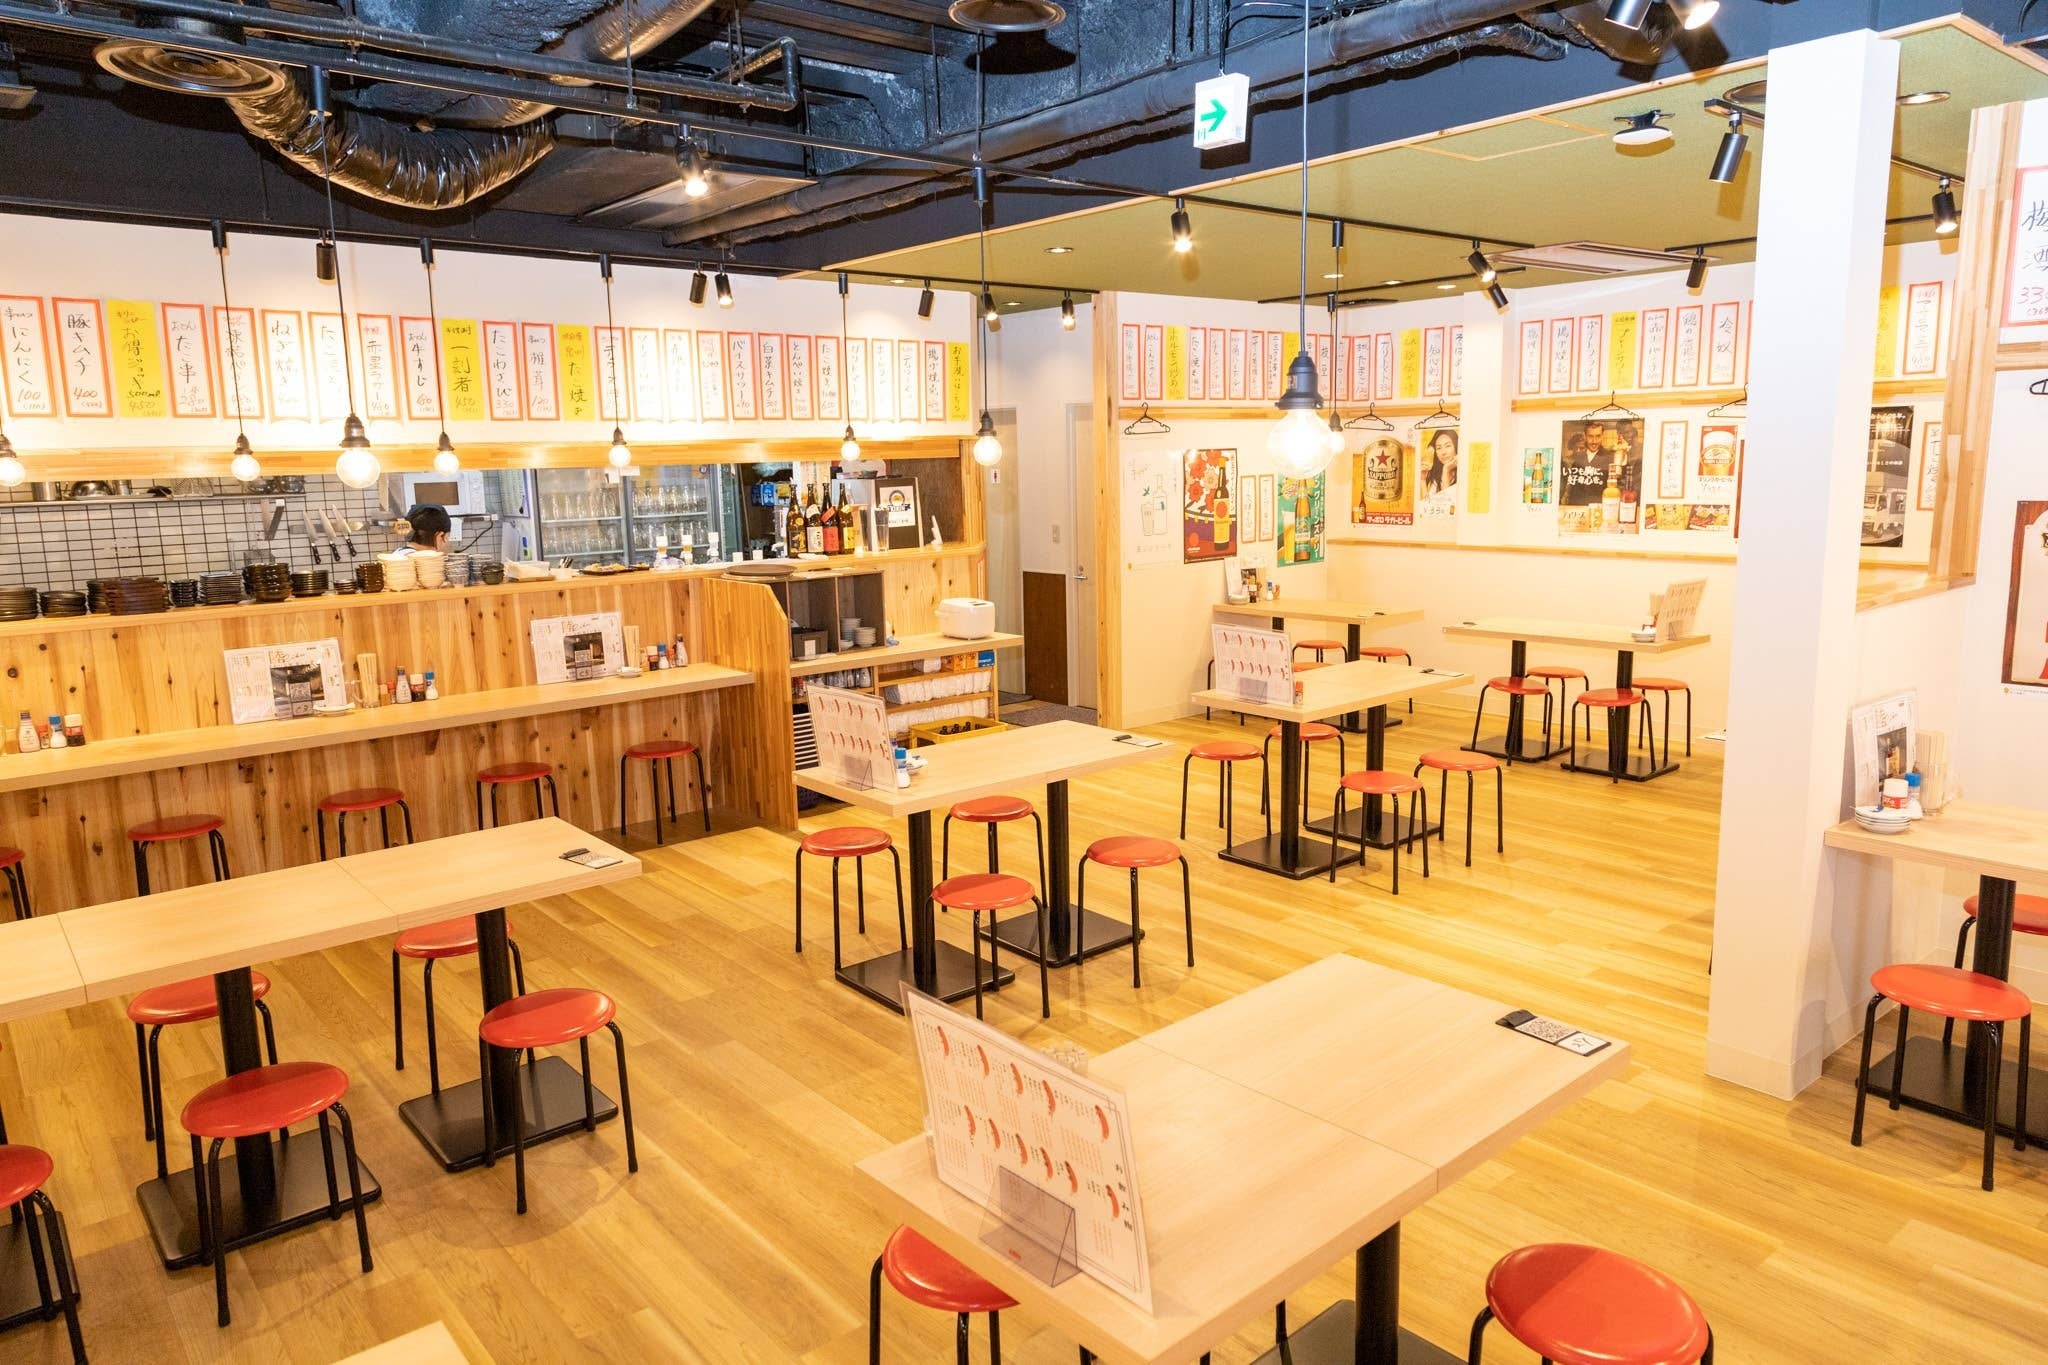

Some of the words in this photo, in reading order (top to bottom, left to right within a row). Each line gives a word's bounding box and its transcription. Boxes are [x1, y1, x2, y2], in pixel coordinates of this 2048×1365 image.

[12, 326, 33, 386] にんにく
[66, 313, 91, 378] 豚キムチ
[175, 335, 197, 385] たこ串
[1714, 315, 1735, 354] 冷奴
[366, 340, 385, 401] 赤星ラガー
[411, 342, 428, 388] 牛すじ
[449, 343, 473, 394] 一刻者
[493, 328, 513, 399] たこわさび
[567, 361, 590, 417] たこ焼き
[762, 342, 777, 399] 白菜キムチ
[17, 388, 41, 403] 100
[73, 386, 99, 401] 400
[1368, 470, 1398, 480] SAPPORO
